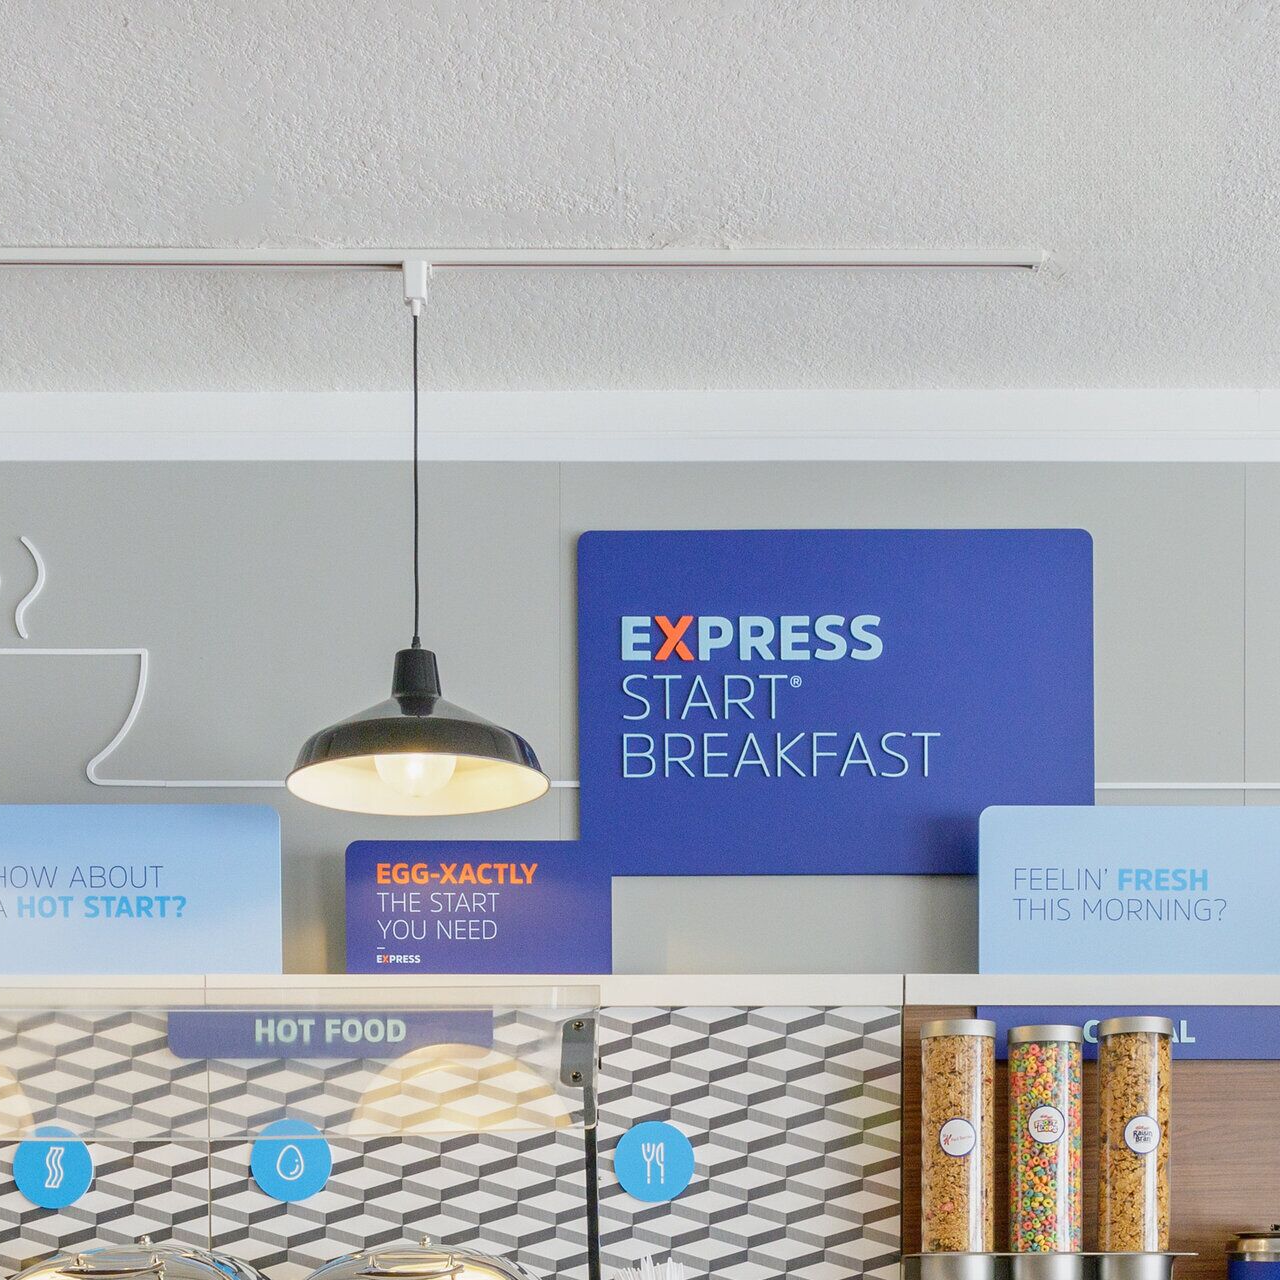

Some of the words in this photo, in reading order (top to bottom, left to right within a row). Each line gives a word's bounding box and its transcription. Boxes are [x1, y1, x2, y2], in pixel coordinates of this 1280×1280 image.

[621, 614, 883, 661] EXPRESS
[622, 732, 941, 778] BREAKFAST
[68, 865, 164, 889] ABOUT
[376, 863, 538, 885] EGG-XACTLY
[1118, 868, 1208, 891] FRESH
[17, 896, 73, 919] HOT
[84, 895, 187, 919] START?
[377, 892, 421, 913] THE
[430, 892, 500, 913] START
[1013, 898, 1071, 921] THIS
[1082, 898, 1227, 921] MORNING?
[377, 919, 426, 940] YOU
[437, 919, 497, 940] NEED
[376, 954, 421, 964] EXPRESS
[255, 1018, 315, 1043] HOT
[325, 1018, 407, 1043] FOOD
